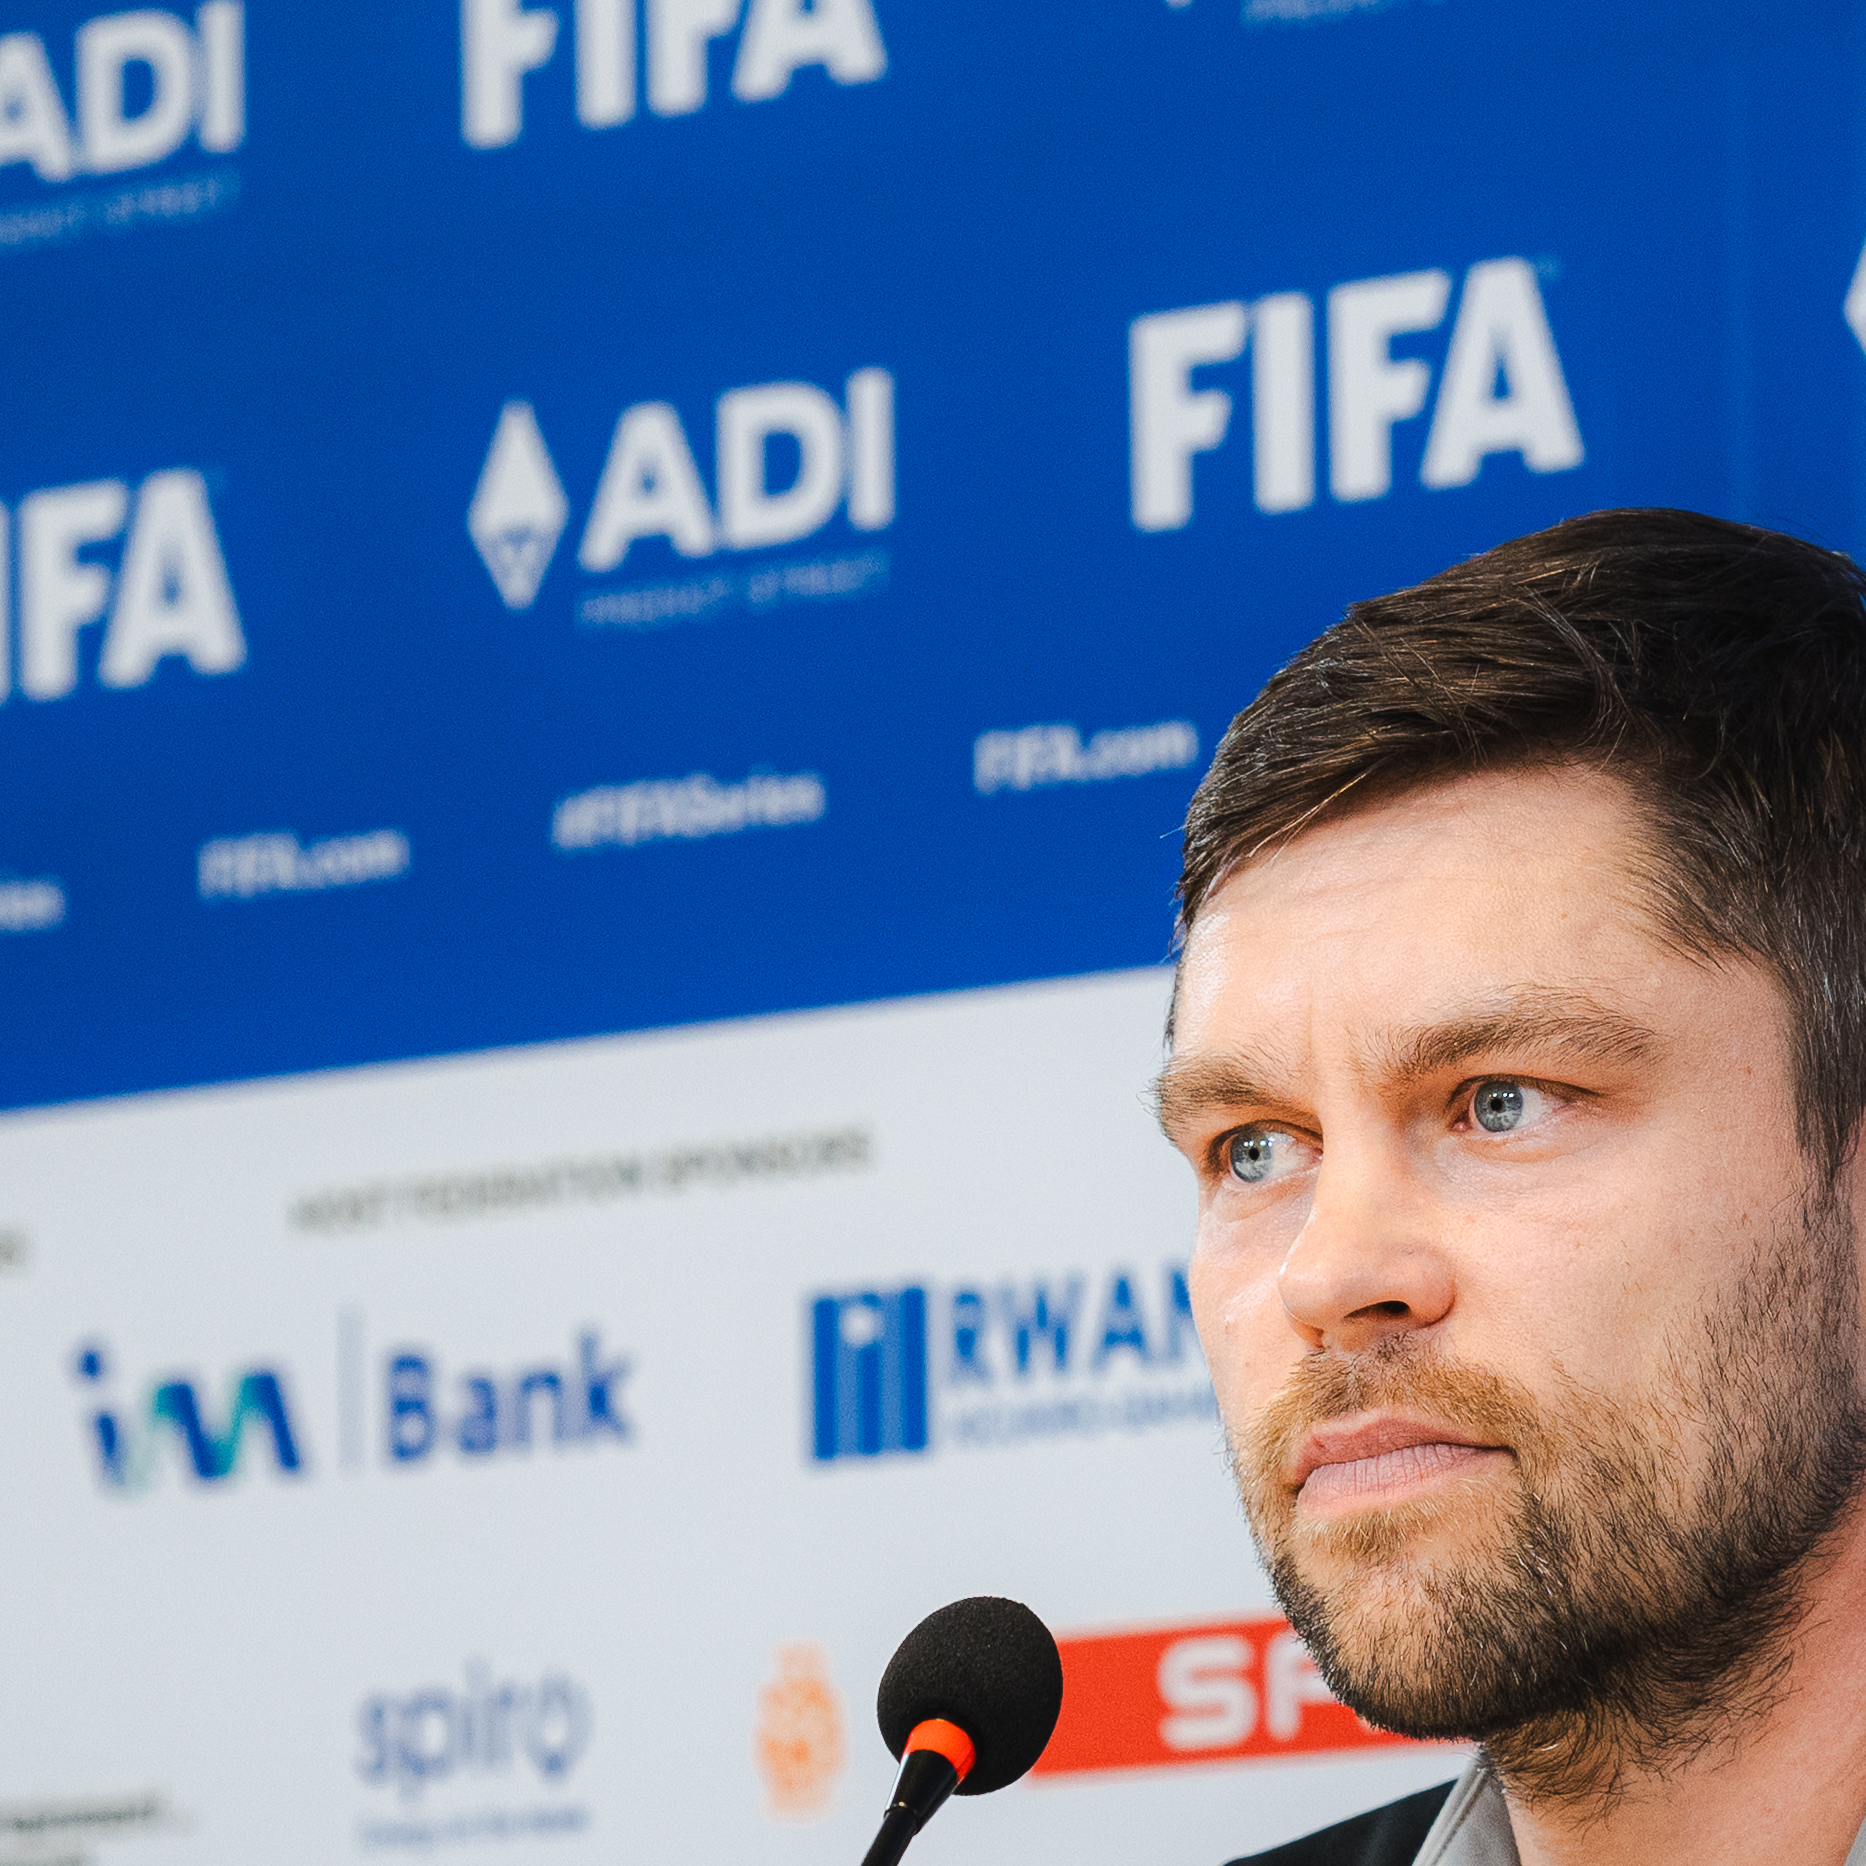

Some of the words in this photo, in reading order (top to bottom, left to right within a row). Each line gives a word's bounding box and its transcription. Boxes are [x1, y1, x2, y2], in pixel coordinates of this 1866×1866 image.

[579, 368, 895, 573] ADI
[1129, 257, 1585, 530] FIFA
[383, 1325, 634, 1466] Bank
[355, 1655, 592, 1806] spiro
